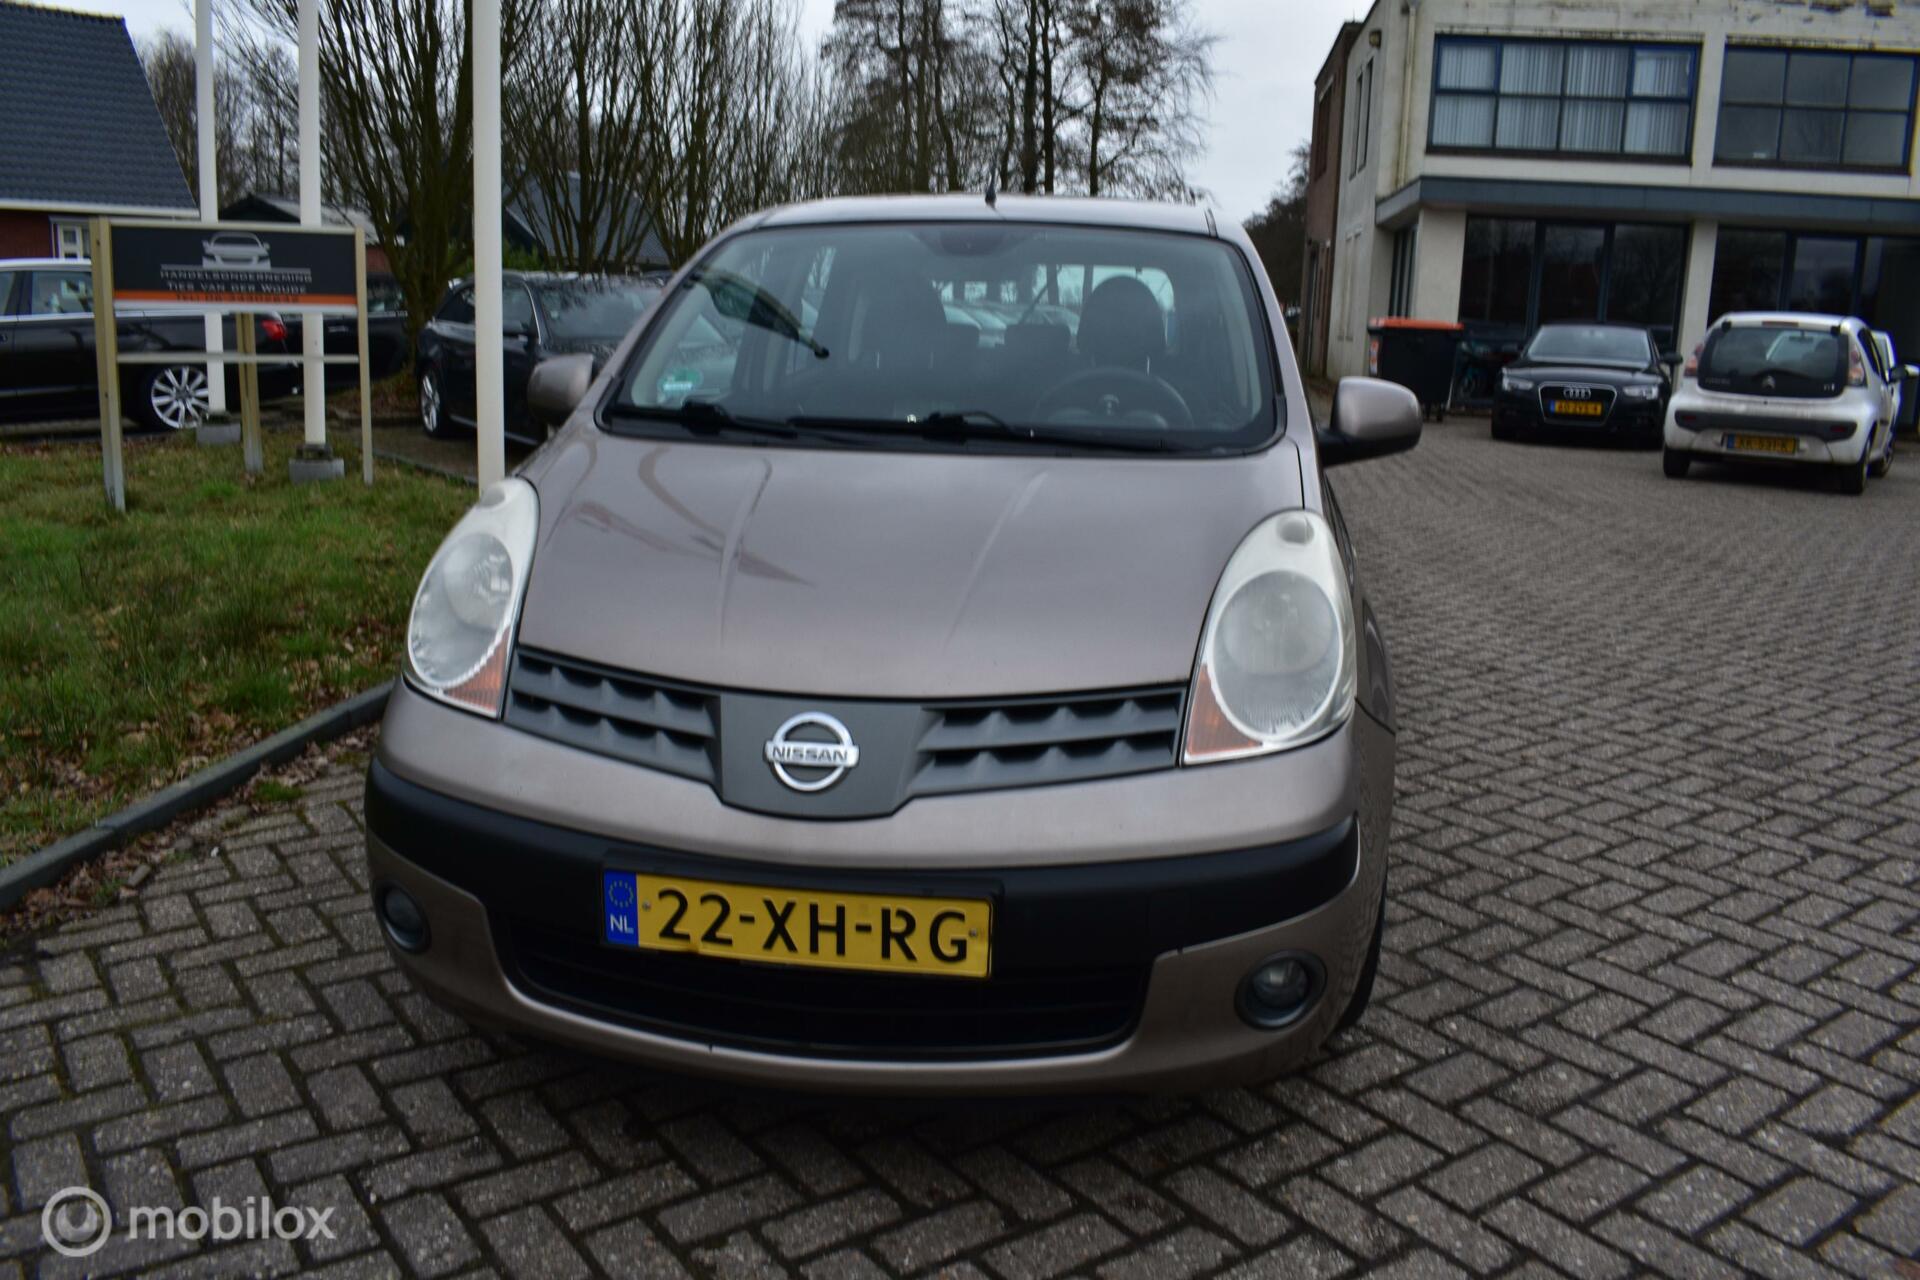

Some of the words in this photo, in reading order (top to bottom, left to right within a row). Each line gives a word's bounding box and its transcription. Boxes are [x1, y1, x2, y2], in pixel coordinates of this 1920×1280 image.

[160, 270, 312, 283] HANDELSONDERNEMING
[772, 746, 848, 763] NISSAN
[609, 914, 634, 934] NL
[656, 887, 969, 963] 22-XH-RG
